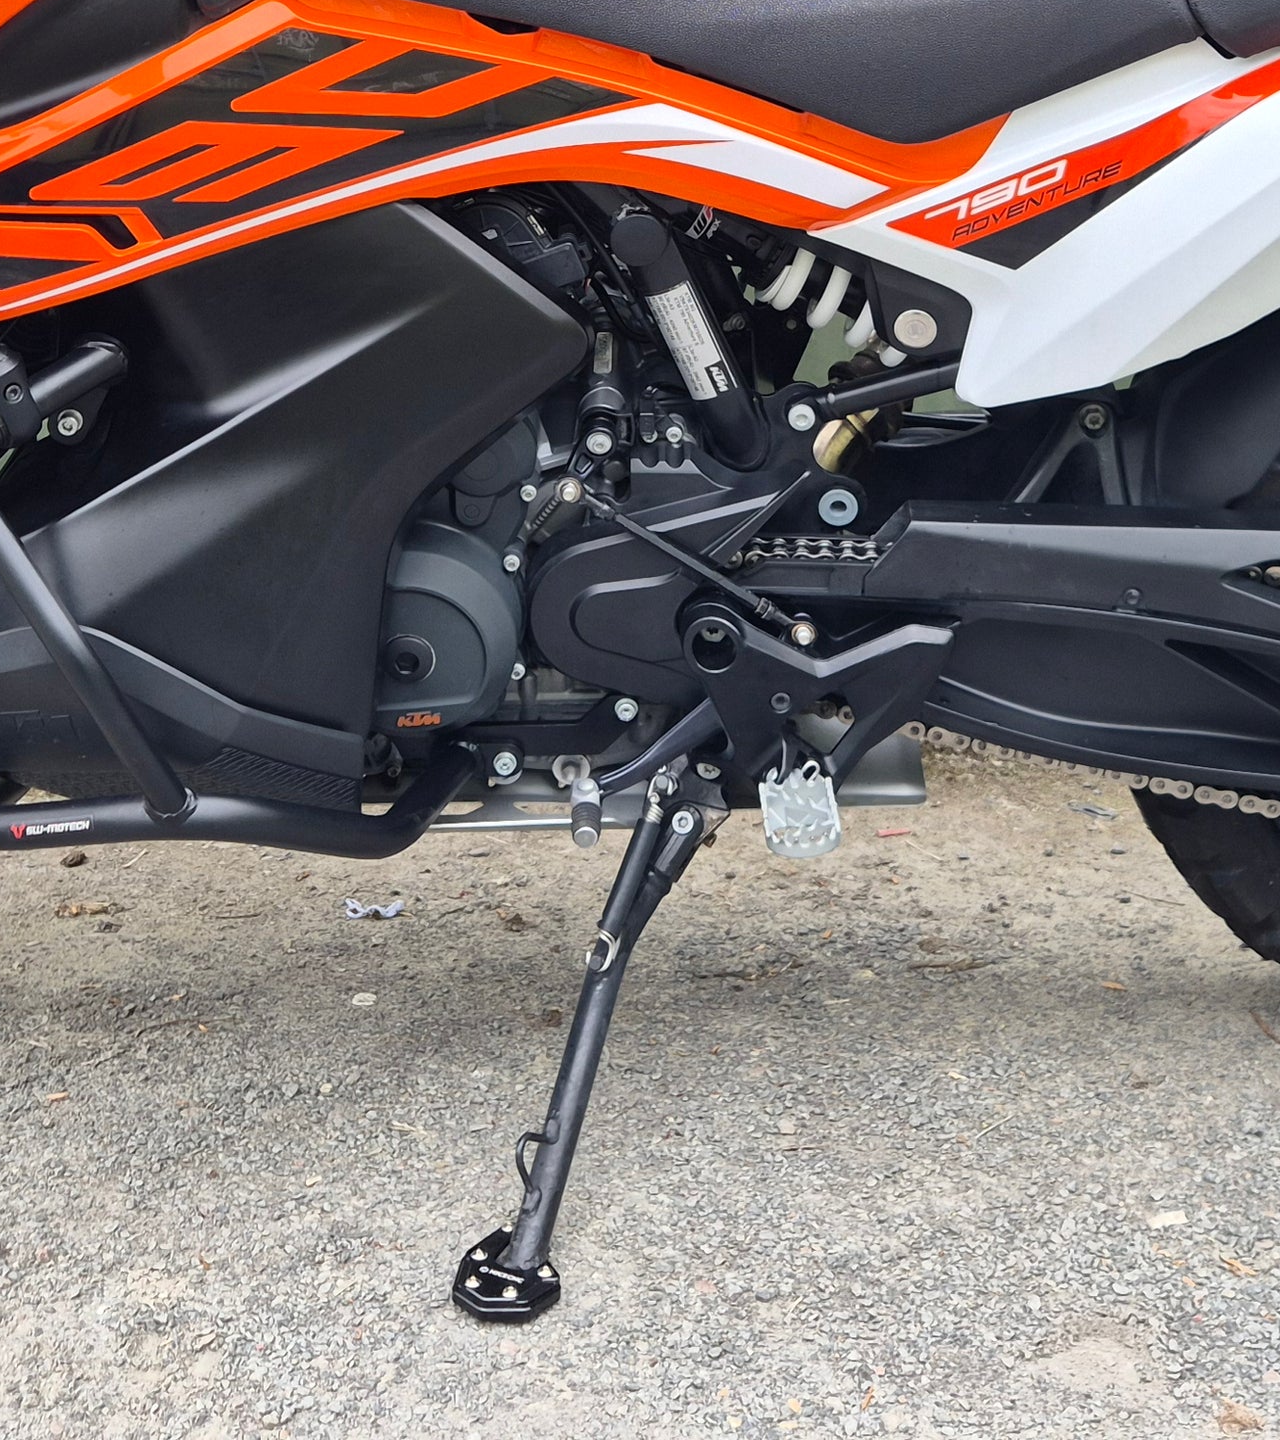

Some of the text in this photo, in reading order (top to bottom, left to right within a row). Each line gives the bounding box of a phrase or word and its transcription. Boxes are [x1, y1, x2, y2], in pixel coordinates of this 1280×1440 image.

[924, 158, 1069, 221] 790
[951, 159, 1124, 242] ADVENTURE
[708, 366, 730, 392] KTM
[397, 710, 441, 728] KTM
[25, 819, 91, 837] SW-MOTECH
